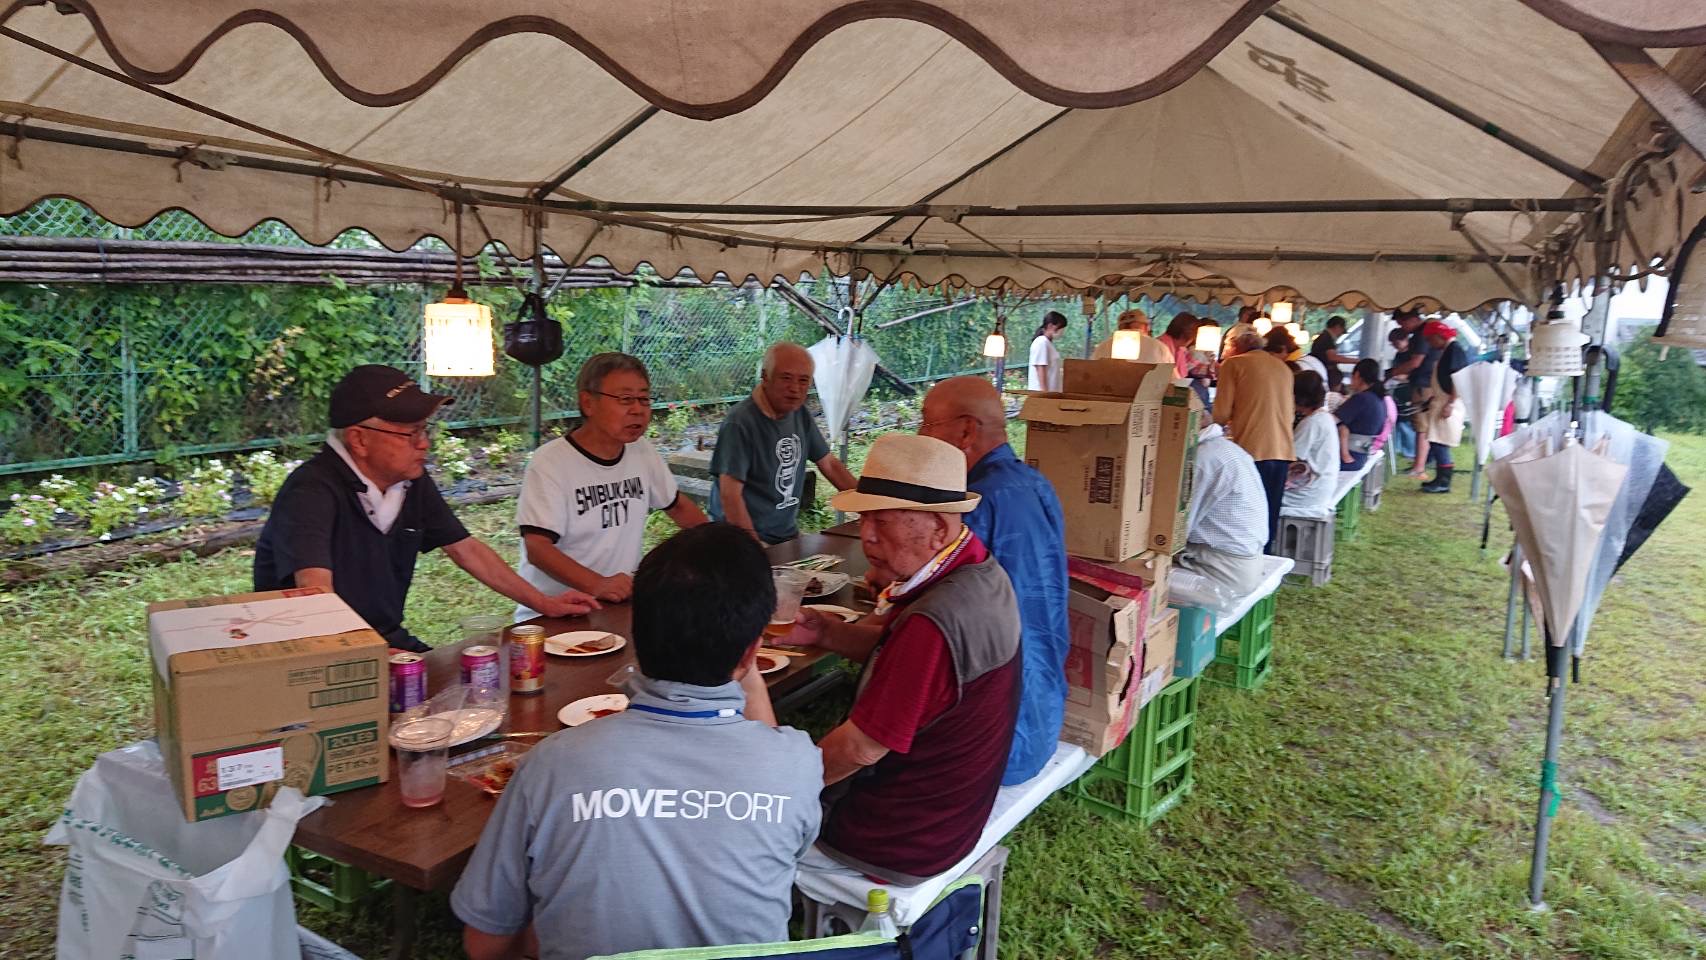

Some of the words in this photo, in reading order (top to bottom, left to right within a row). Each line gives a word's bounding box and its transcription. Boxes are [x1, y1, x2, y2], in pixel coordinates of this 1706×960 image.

[575, 476, 643, 515] SHIBUKAWA
[601, 499, 629, 529] CITY
[572, 788, 791, 824] MOVESPORT
